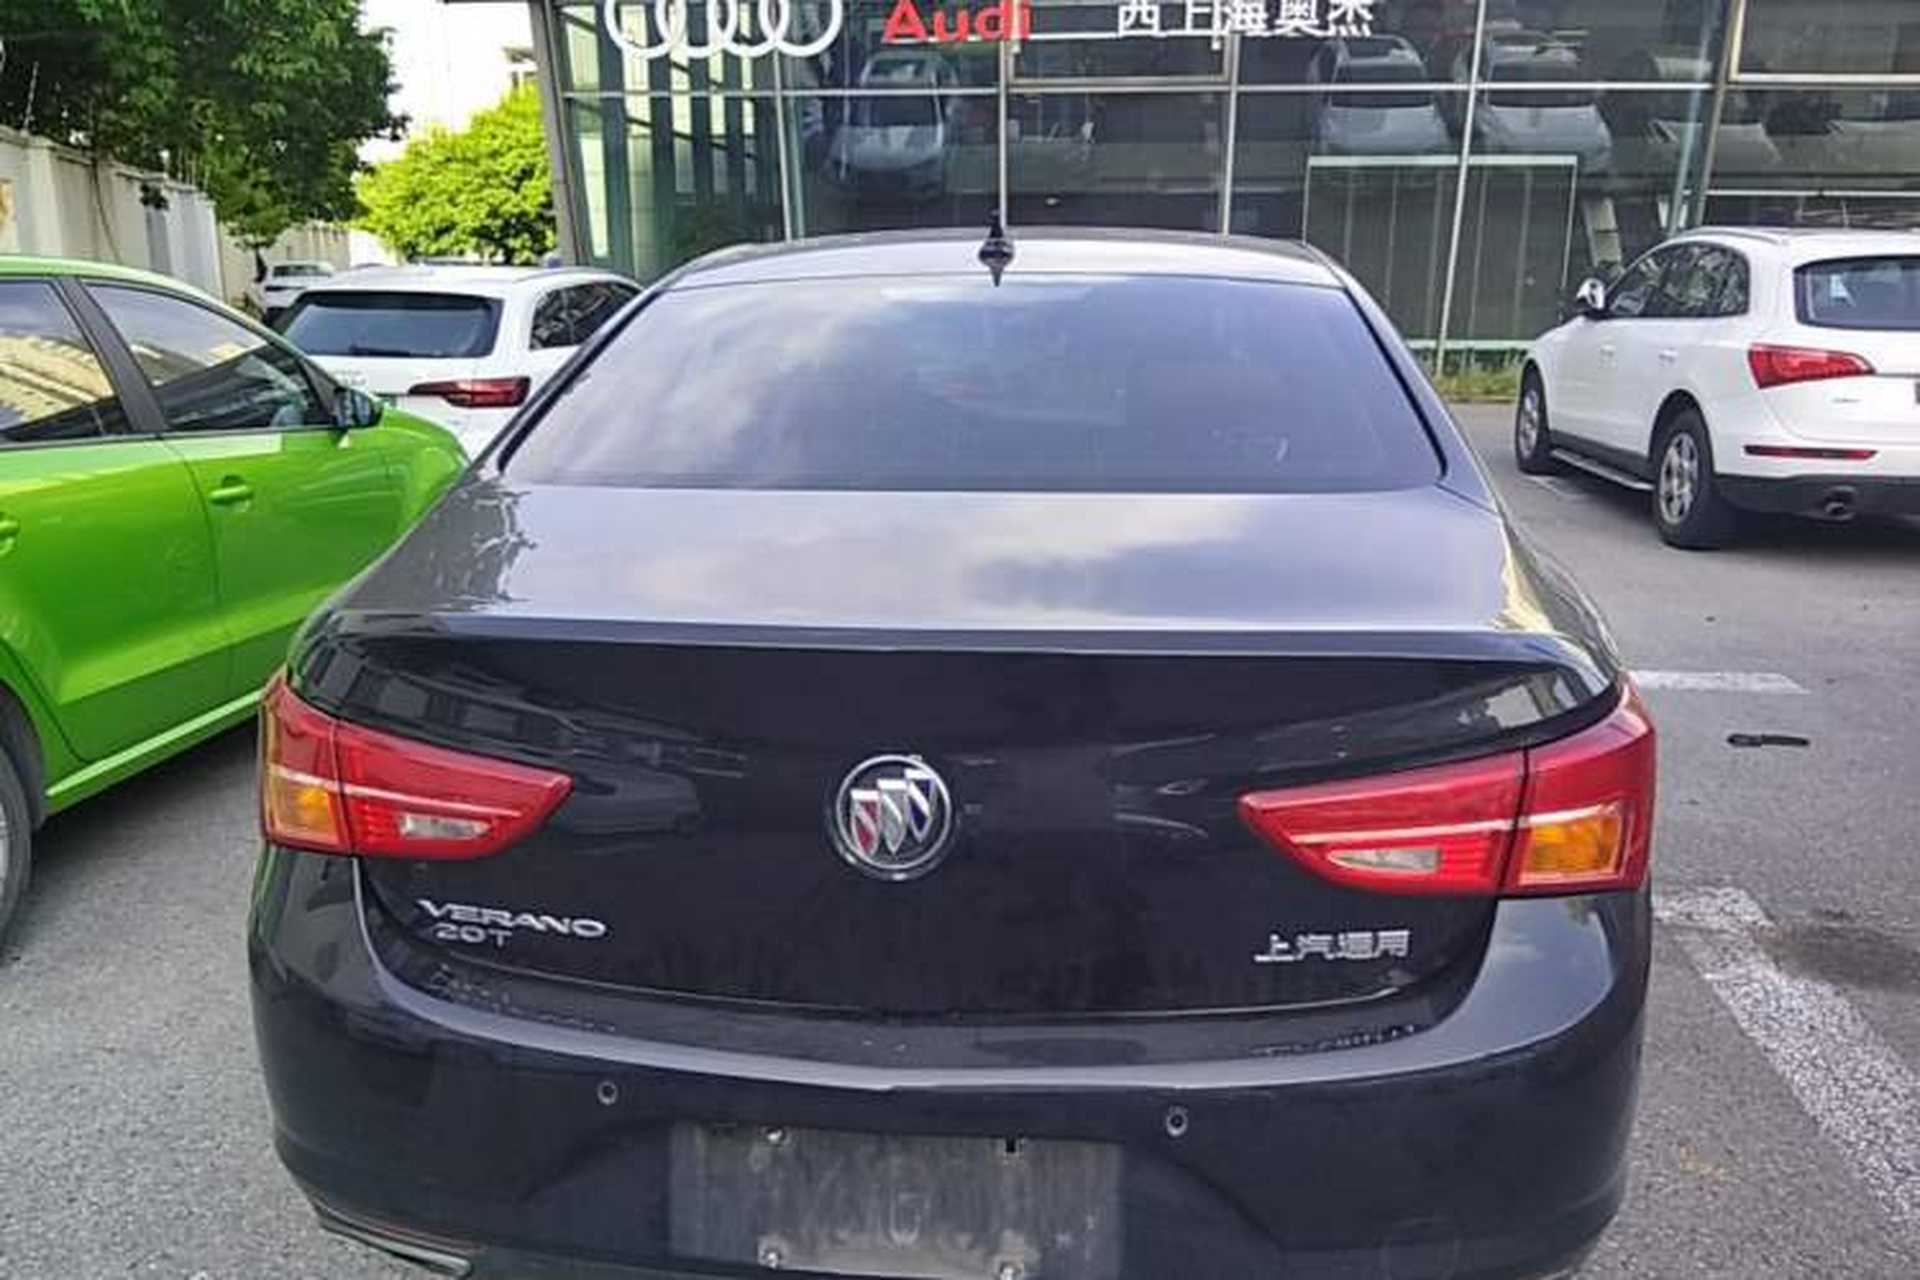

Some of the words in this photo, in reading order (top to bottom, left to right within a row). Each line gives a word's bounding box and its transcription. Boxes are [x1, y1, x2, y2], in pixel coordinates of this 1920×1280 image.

[881, 0, 1031, 43] Audi
[417, 898, 607, 938] VERANO
[434, 922, 513, 948] 20T
[1253, 930, 1411, 963] 上汽通用
